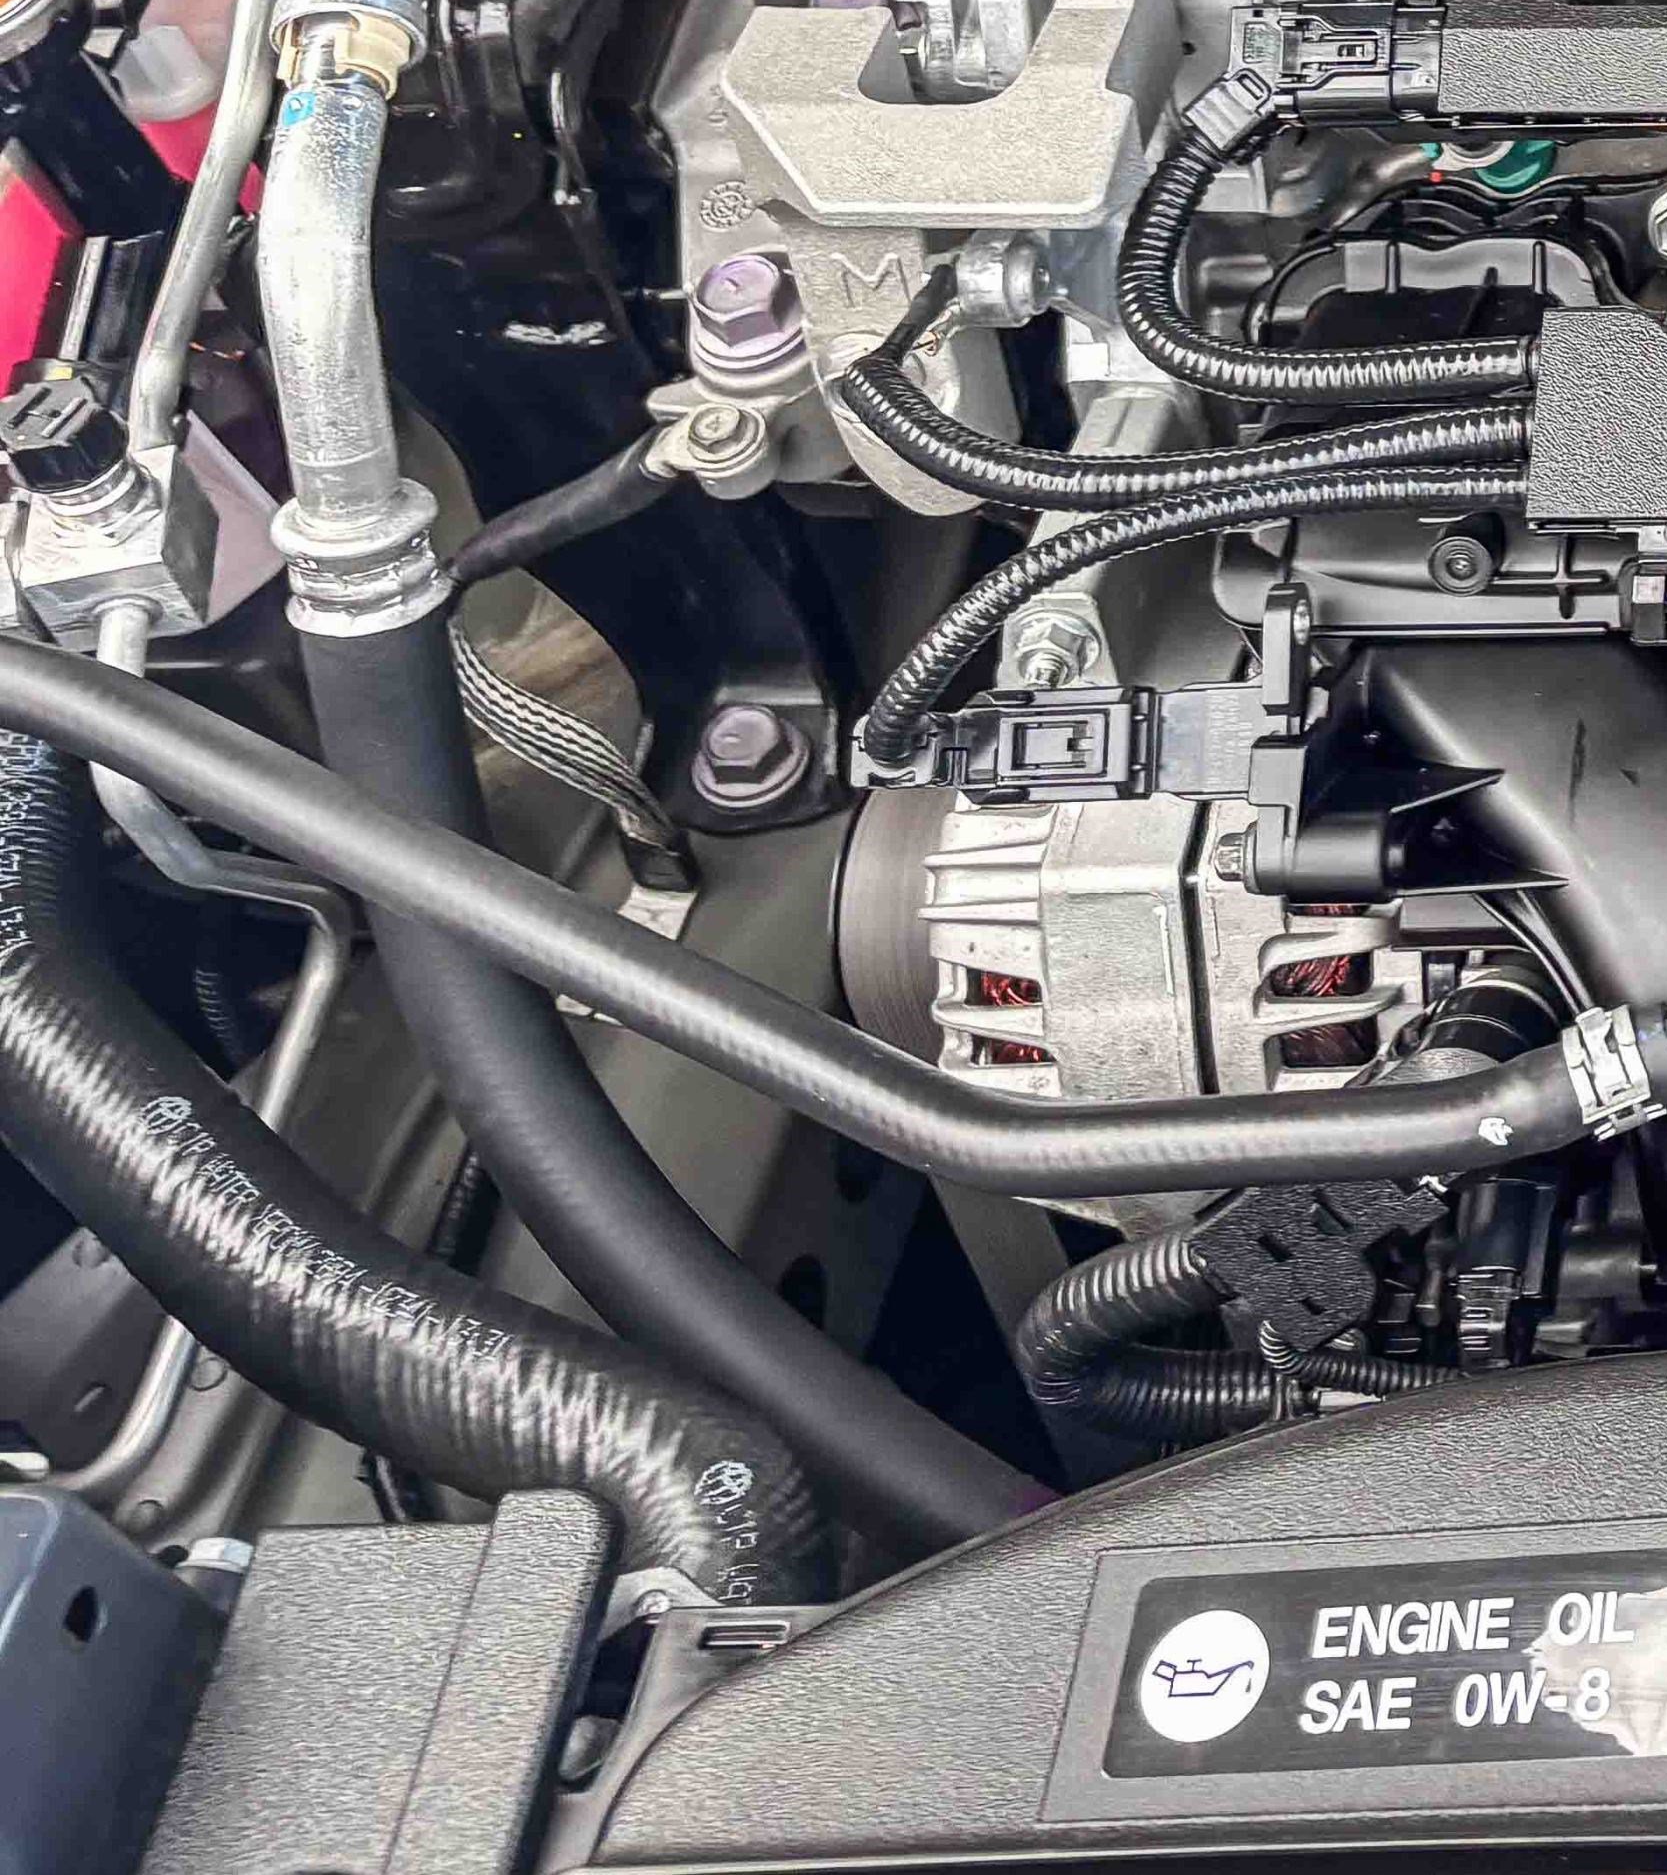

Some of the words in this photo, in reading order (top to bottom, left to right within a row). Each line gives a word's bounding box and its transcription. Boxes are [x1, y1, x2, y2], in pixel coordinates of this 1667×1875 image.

[1311, 1597, 1514, 1659] ENGINE
[1547, 1591, 1635, 1646] OIL
[1300, 1677, 1416, 1734] SAE
[1454, 1667, 1611, 1727] 0W-8
